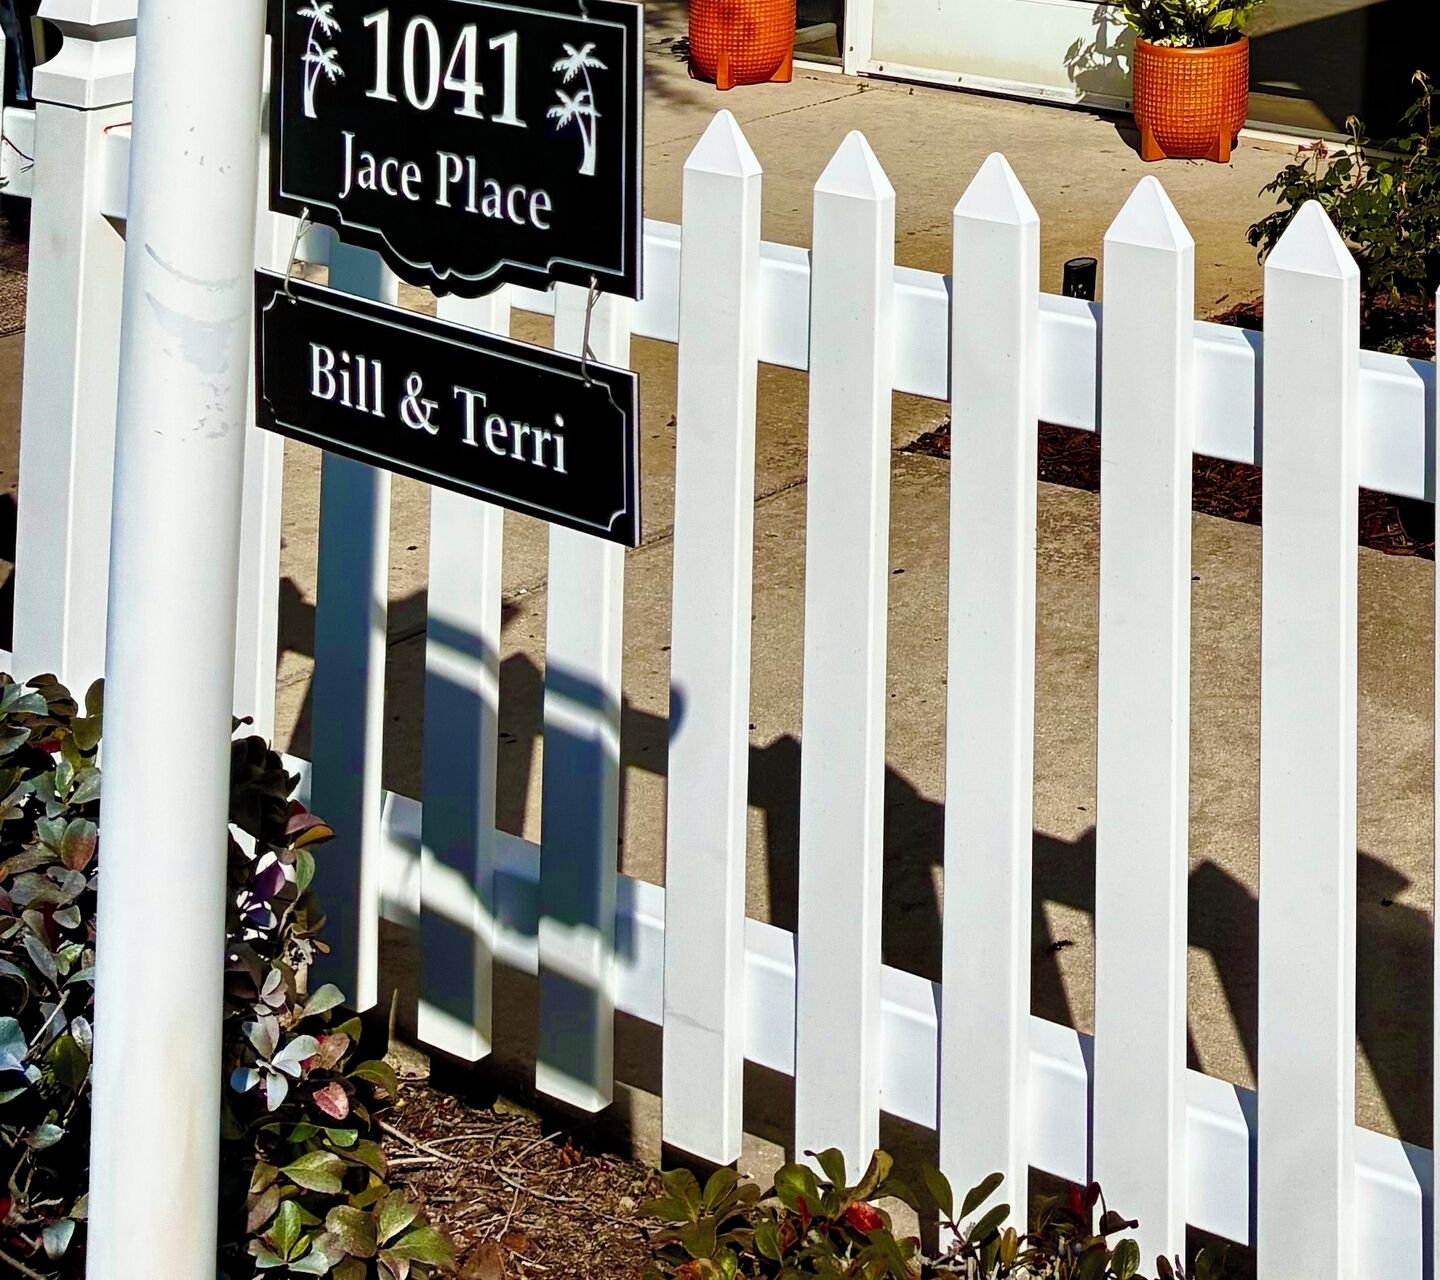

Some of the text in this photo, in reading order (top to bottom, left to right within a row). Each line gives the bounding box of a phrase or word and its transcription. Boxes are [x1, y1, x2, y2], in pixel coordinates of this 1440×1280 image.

[362, 8, 529, 129] 1041
[337, 129, 553, 231] Jace Place
[308, 341, 569, 475] Bill & Terri
